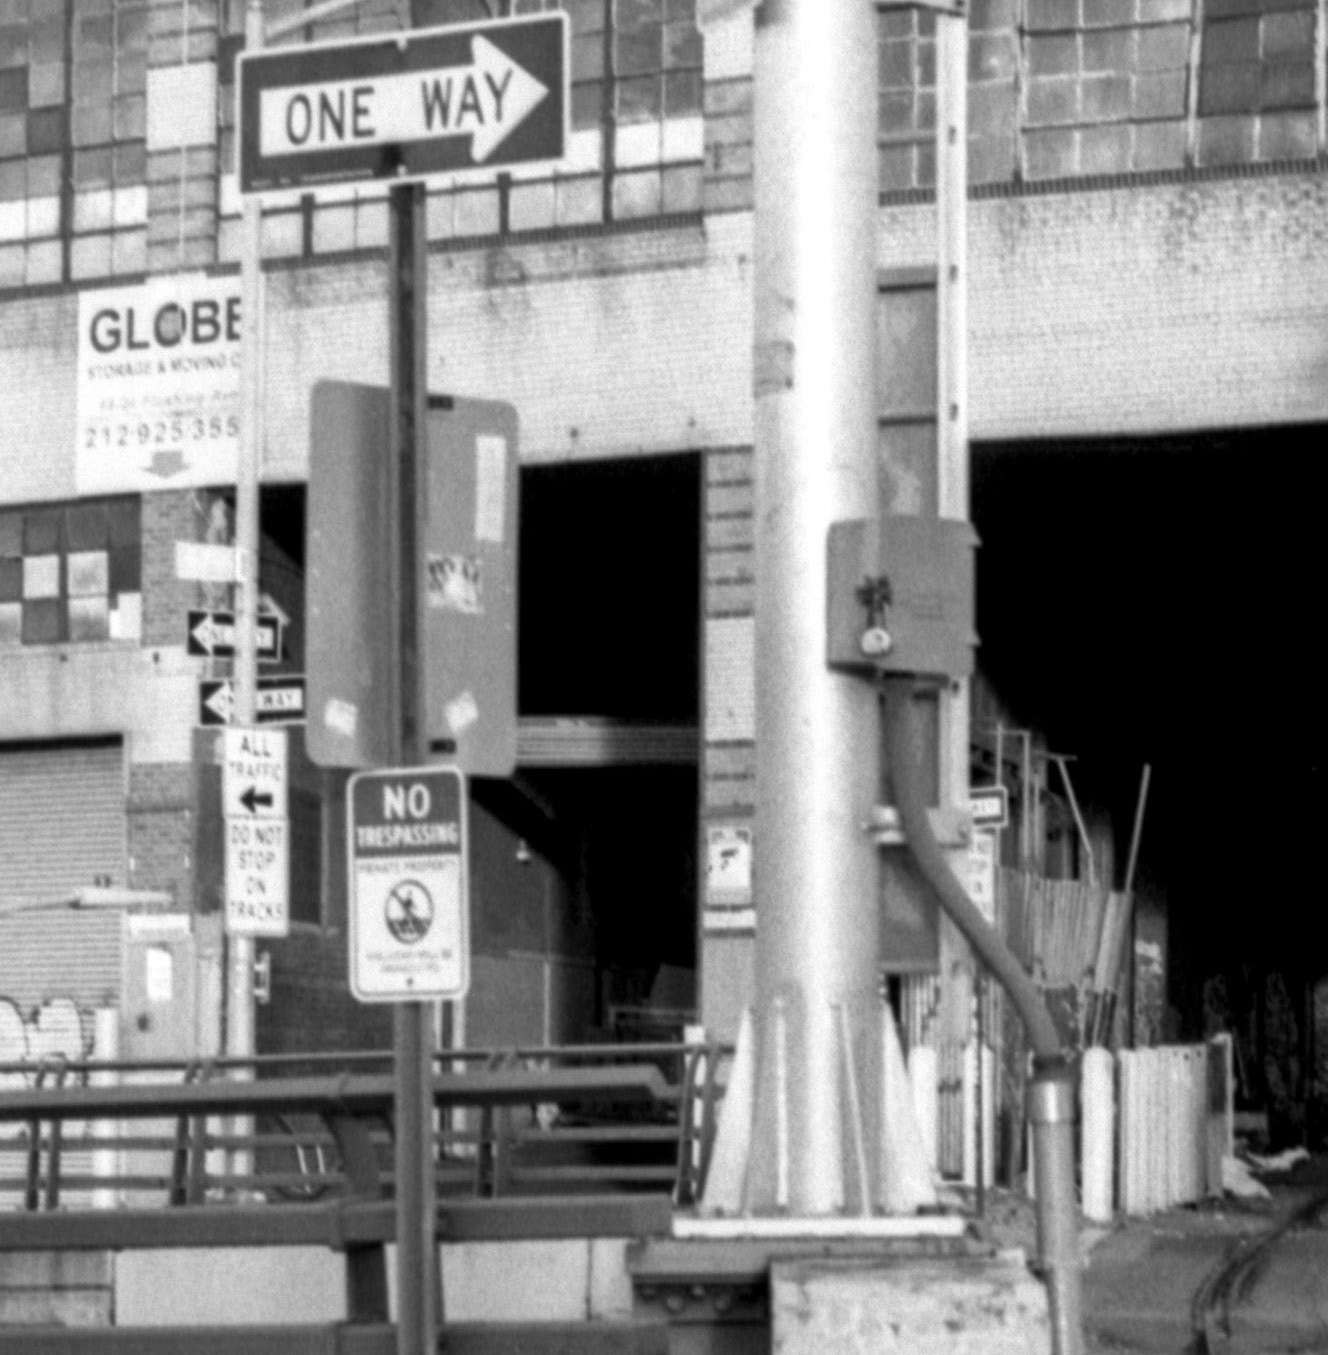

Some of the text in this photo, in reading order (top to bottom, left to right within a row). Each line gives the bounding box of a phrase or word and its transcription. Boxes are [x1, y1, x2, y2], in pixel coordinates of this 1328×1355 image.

[285, 68, 513, 146] ONE WAY
[89, 296, 241, 354] GLOBE
[240, 735, 271, 758] ALL
[229, 761, 282, 782] TRAFFIC
[383, 782, 432, 820] NO
[231, 824, 283, 846] DO NOT
[357, 821, 459, 848] TRESPASSING
[238, 849, 276, 871] STOP
[246, 875, 267, 895] ON
[230, 900, 283, 921] TRACKS
